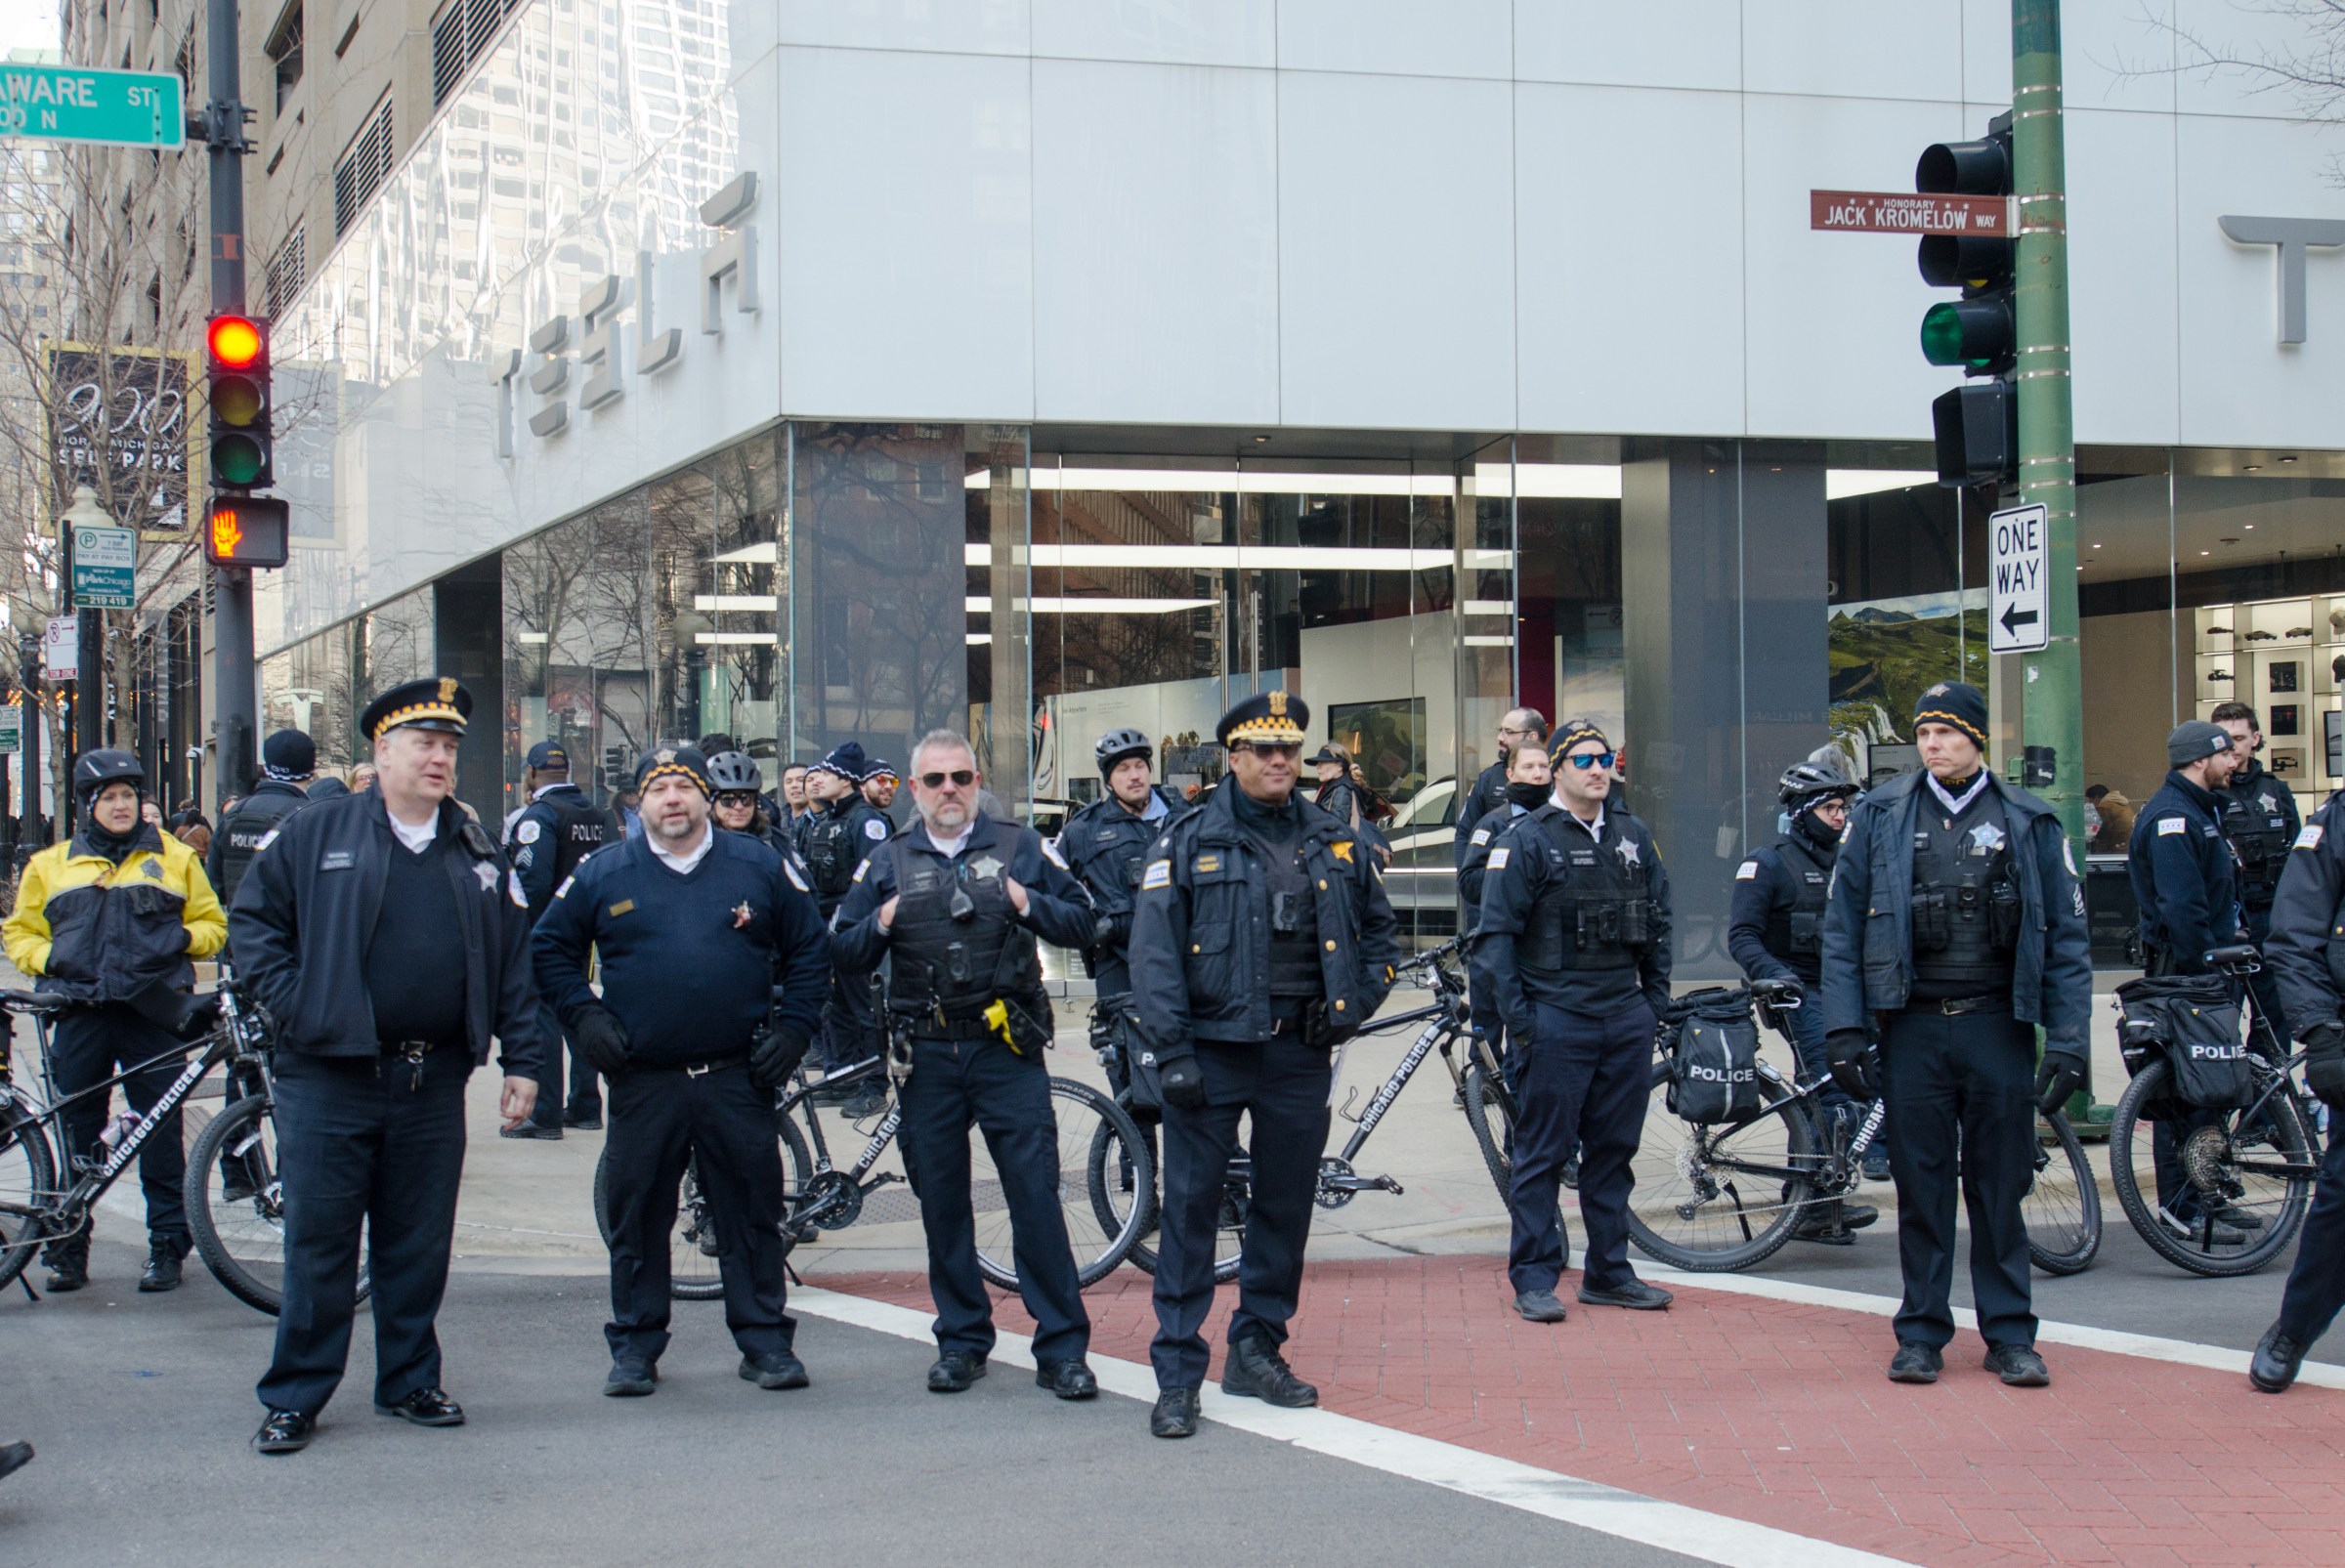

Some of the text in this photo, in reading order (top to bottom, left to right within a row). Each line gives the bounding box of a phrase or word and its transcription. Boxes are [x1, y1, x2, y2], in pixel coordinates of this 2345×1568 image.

[127, 86, 153, 106] ST
[41, 109, 57, 130] N
[1824, 206, 1996, 231] JACK KROMELOW WAY
[1883, 198, 1936, 210] HONORARY
[488, 171, 759, 459] TESLA
[1997, 519, 2038, 556] ONE
[1996, 558, 2039, 595] WAY
[89, 596, 107, 605] 219
[108, 597, 128, 606] 419
[1359, 1036, 1431, 1133] CHICAGO POLICE
[1690, 1064, 1754, 1082] POLICE
[104, 1070, 195, 1177] CHICAGO POLICE
[858, 1112, 902, 1170] CHICAGO
